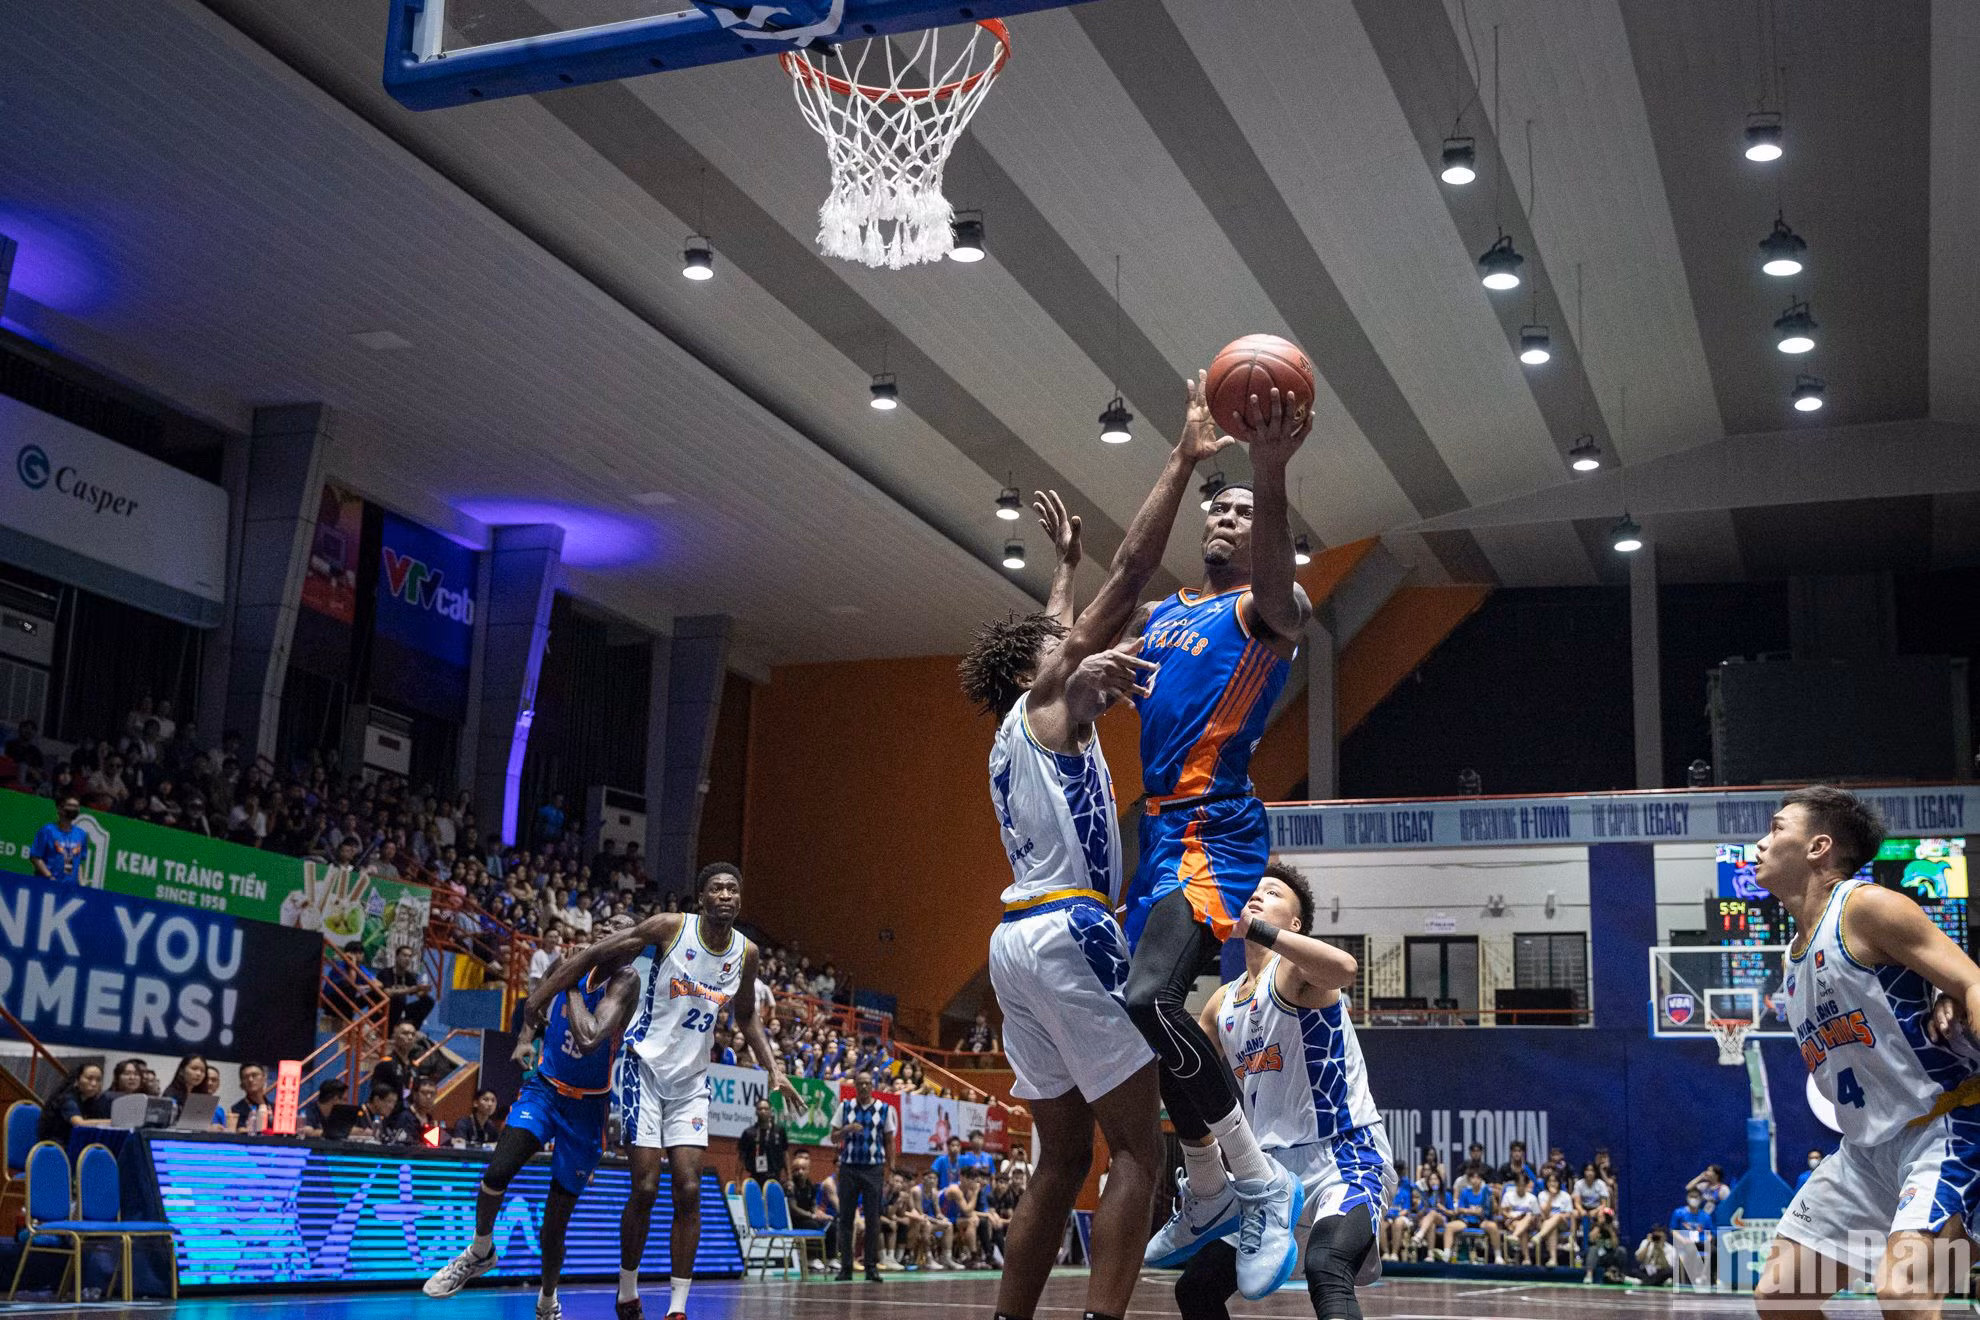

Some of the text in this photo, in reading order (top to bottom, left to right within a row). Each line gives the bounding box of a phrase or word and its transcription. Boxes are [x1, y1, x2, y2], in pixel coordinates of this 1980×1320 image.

[56, 466, 138, 516] Casper
[1343, 810, 1434, 845] THE CAPITAL LEGACY
[1460, 805, 1570, 842] REPRESENTING H-TOWN
[1591, 802, 1690, 838] THE CAPITAL LEGACY
[1914, 793, 1965, 830] LEGACY
[1277, 813, 1324, 847] H-TOWN
[115, 849, 158, 879] KEM
[155, 884, 197, 906] SINCE
[114, 904, 244, 981] YOU
[681, 1007, 715, 1034] 23
[1837, 1067, 1867, 1109] 4
[1431, 1109, 1550, 1190] H-TOWN
